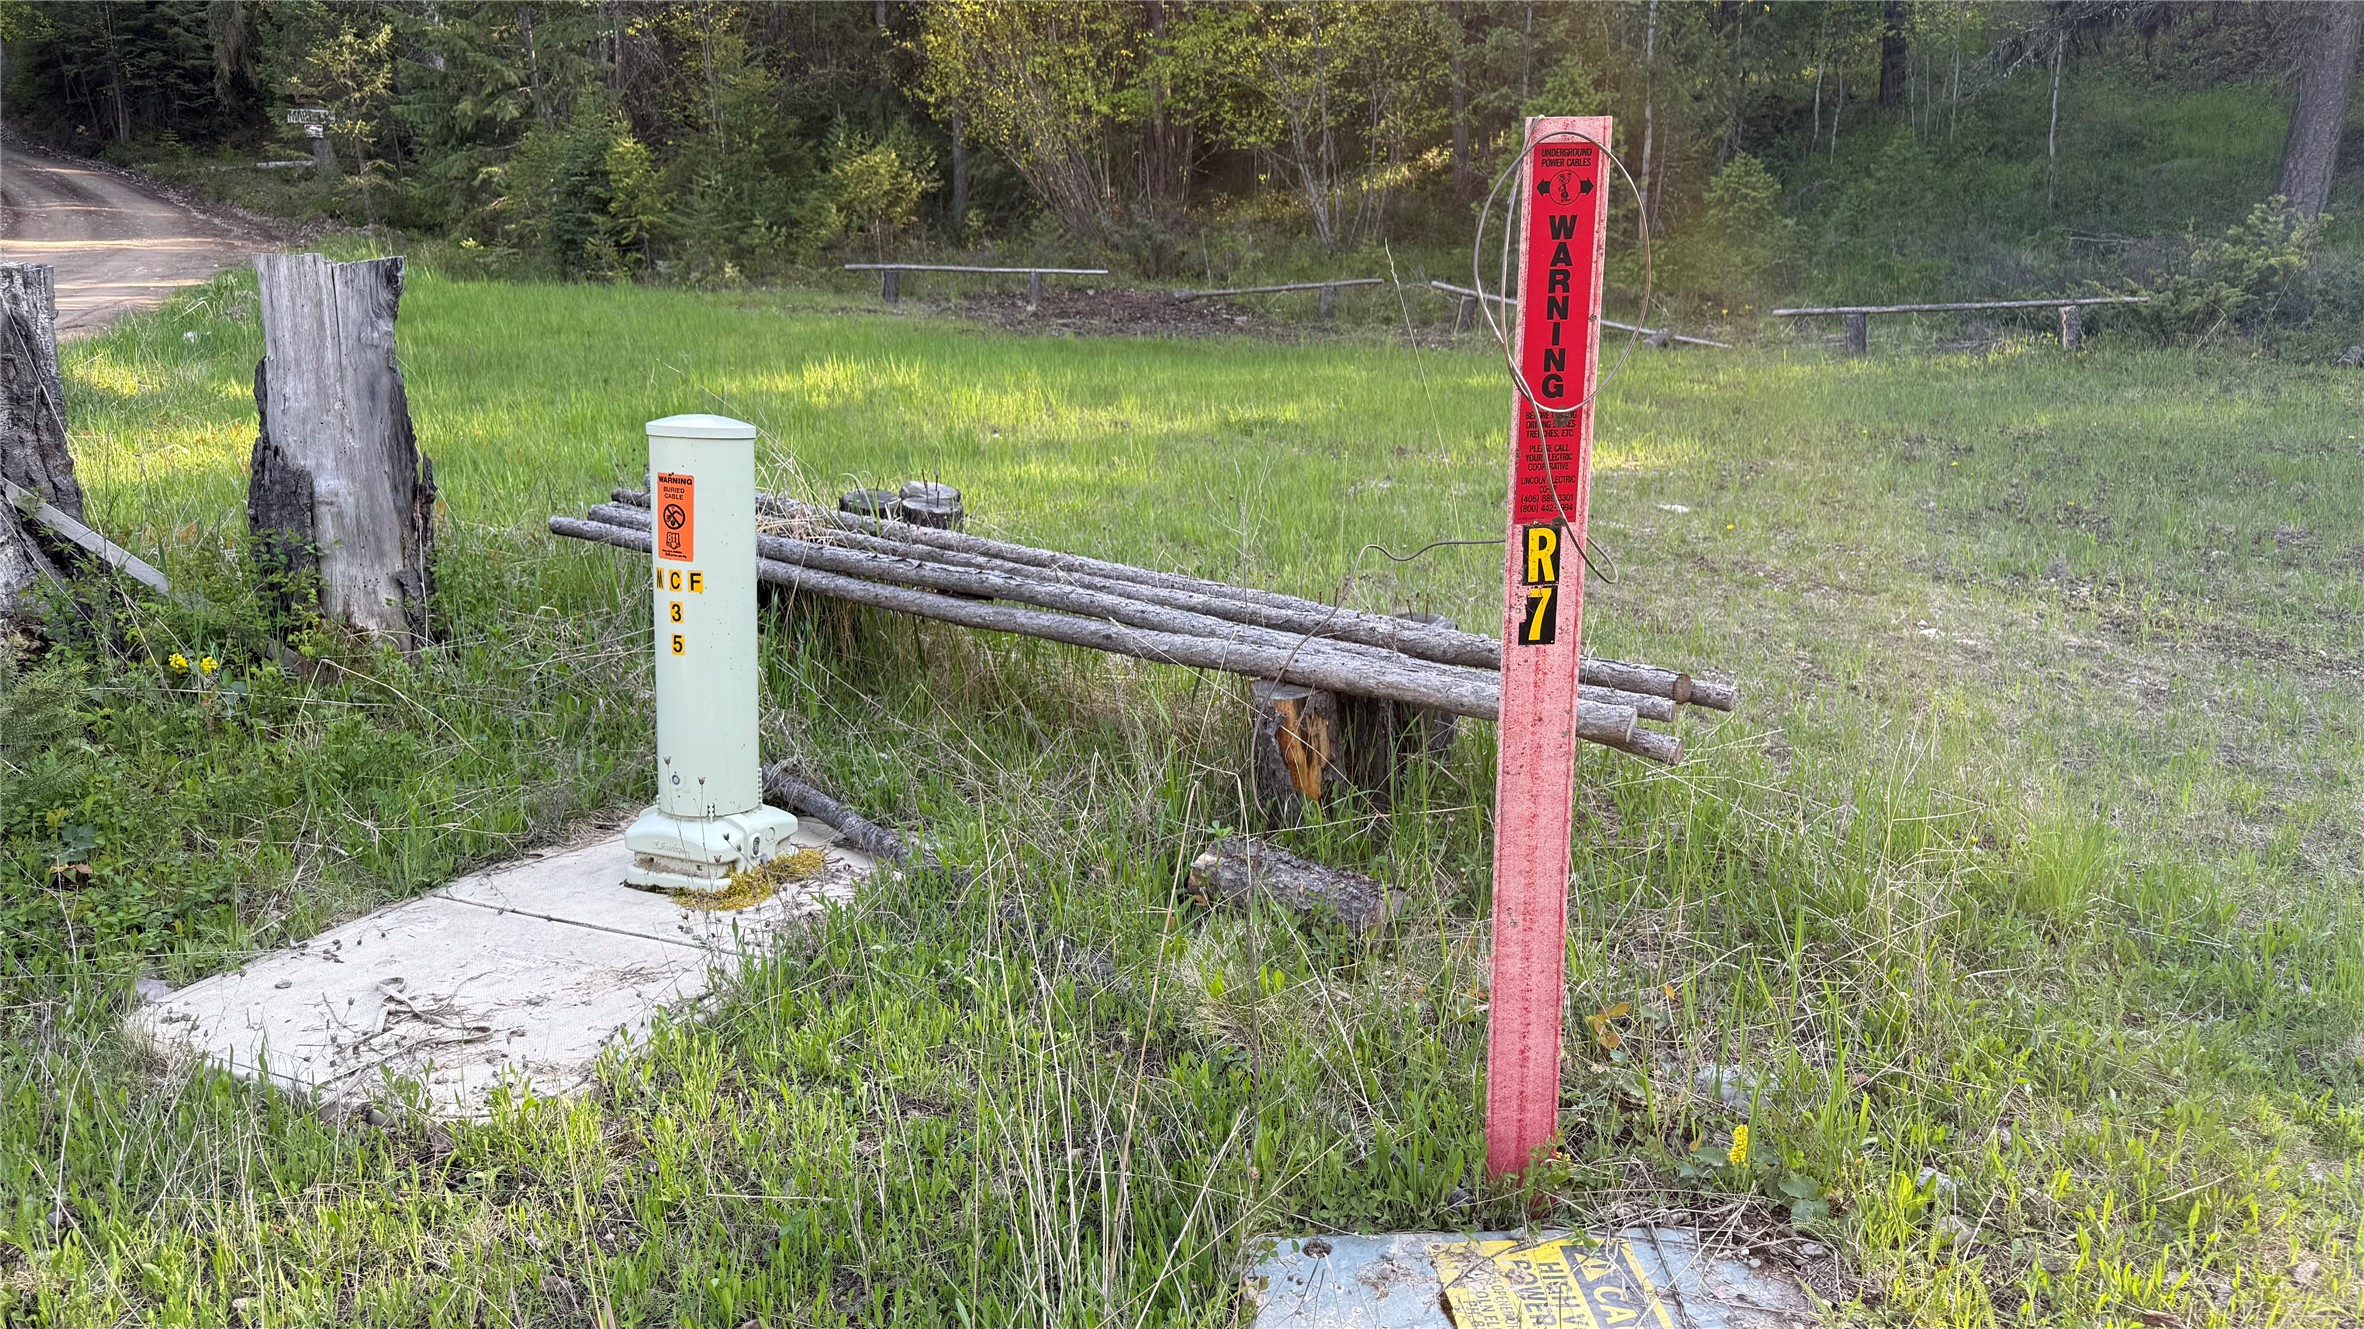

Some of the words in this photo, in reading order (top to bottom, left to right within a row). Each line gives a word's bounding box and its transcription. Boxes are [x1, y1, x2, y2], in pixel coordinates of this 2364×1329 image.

[1541, 148, 1592, 157] UNDERGROUND
[1541, 159, 1565, 167] POWER
[1566, 158, 1592, 167] CABLES
[1541, 214, 1578, 399] WARNING
[1529, 444, 1552, 453] PLESE
[1554, 443, 1570, 452] CALL
[1546, 452, 1573, 461] LECTRIC
[1527, 462, 1570, 472] COOPRATIVE
[658, 475, 693, 486] WARNING
[1521, 476, 1547, 485] LINCOLN
[1549, 475, 1576, 484] LECTRIC
[663, 486, 685, 494] BURIED
[664, 492, 684, 500] CABLE
[1521, 494, 1540, 504] (406)
[1520, 504, 1539, 513] (800)
[1541, 503, 1573, 512] 442-994
[667, 532, 680, 544] 811
[1527, 527, 1557, 583] R
[671, 603, 682, 622] 3
[1527, 587, 1553, 641] 7
[673, 634, 683, 653] 5
[1594, 1286, 1645, 1329] CA
